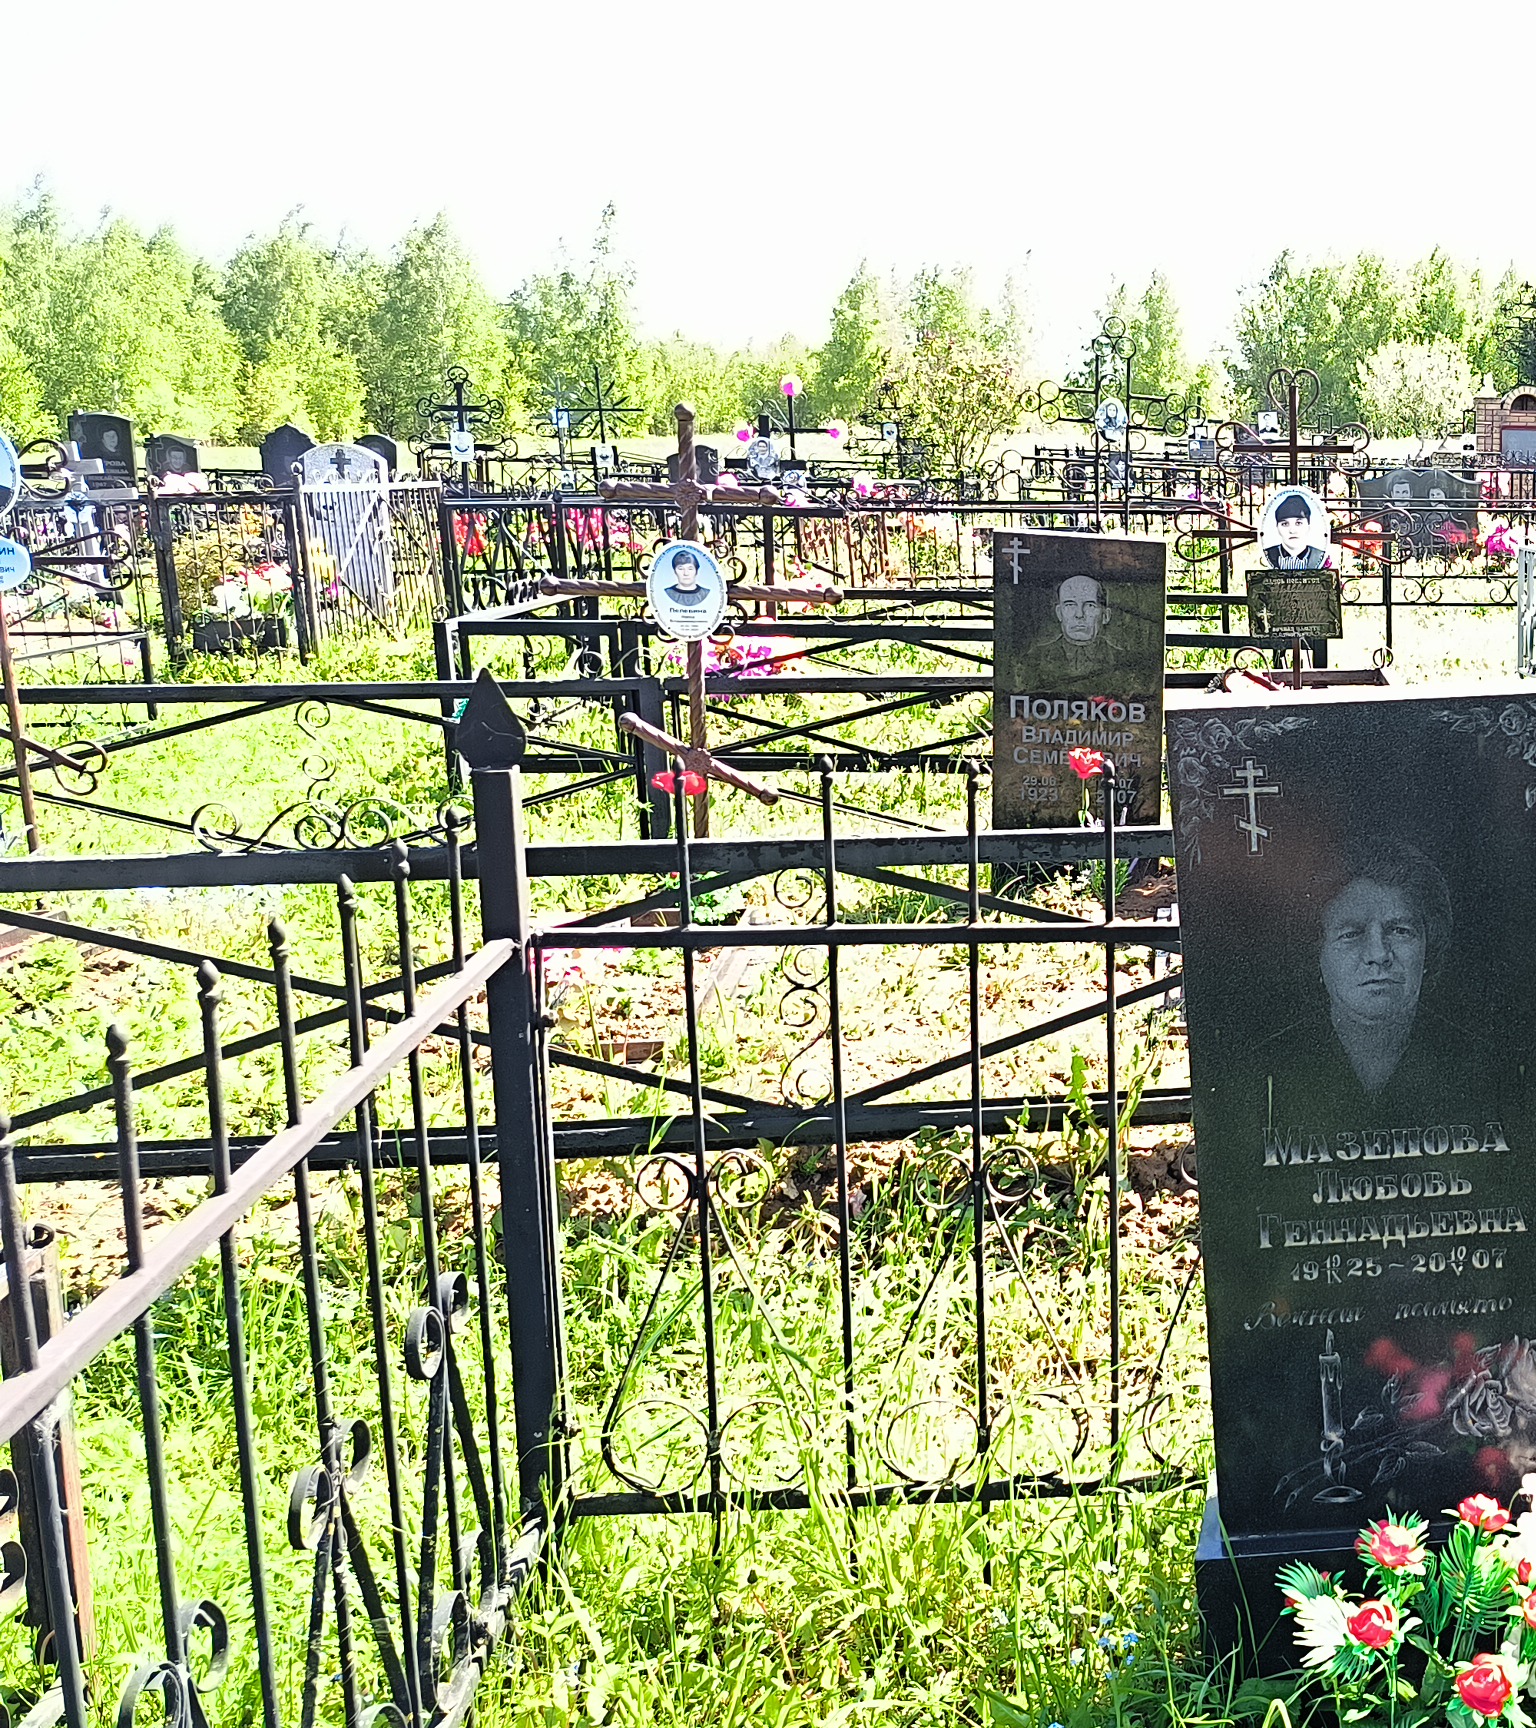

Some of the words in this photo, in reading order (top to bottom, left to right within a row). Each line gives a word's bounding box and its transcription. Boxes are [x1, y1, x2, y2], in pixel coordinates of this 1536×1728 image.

[1009, 695, 1147, 724] ПОЛЯКОВ
[1021, 725, 1134, 748] ВЛАДИМИР
[1020, 787, 1059, 802] 1923
[1096, 790, 1137, 804] 207
[1022, 775, 1057, 787] 29.06
[1262, 1122, 1511, 1167] МАЗЕПОВА
[1312, 1168, 1473, 1204] ЛЮБОВЬ
[1257, 1206, 1528, 1249] ГЕННАДЬЕВНА
